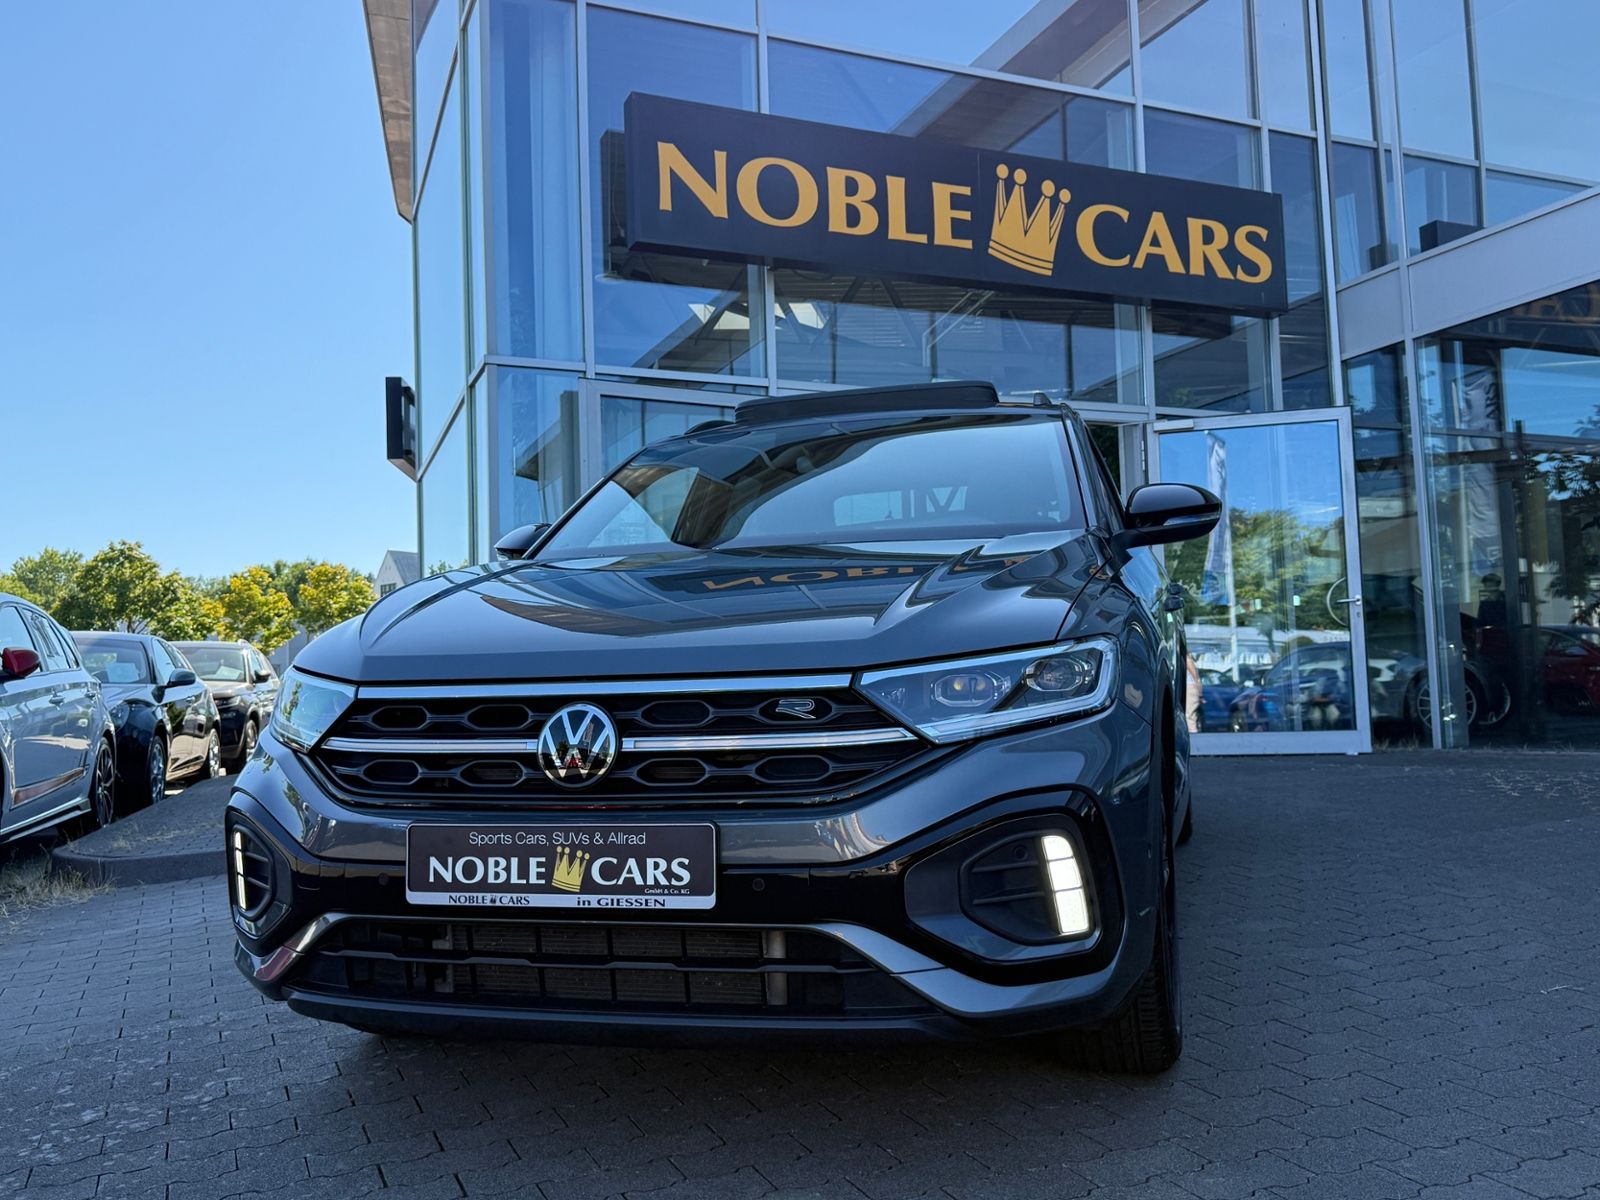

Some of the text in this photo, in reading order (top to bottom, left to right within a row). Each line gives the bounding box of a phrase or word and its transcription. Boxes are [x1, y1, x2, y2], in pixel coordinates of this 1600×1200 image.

[657, 141, 1273, 284] NOBLE CARS
[775, 698, 816, 719] R
[540, 706, 614, 785] VW
[469, 832, 646, 846] Sports Cars, SUVs & Allrad
[428, 856, 691, 886] NOBLE CARS
[448, 894, 530, 906] NOBLE CARS
[577, 897, 666, 908] in GIESSEN
